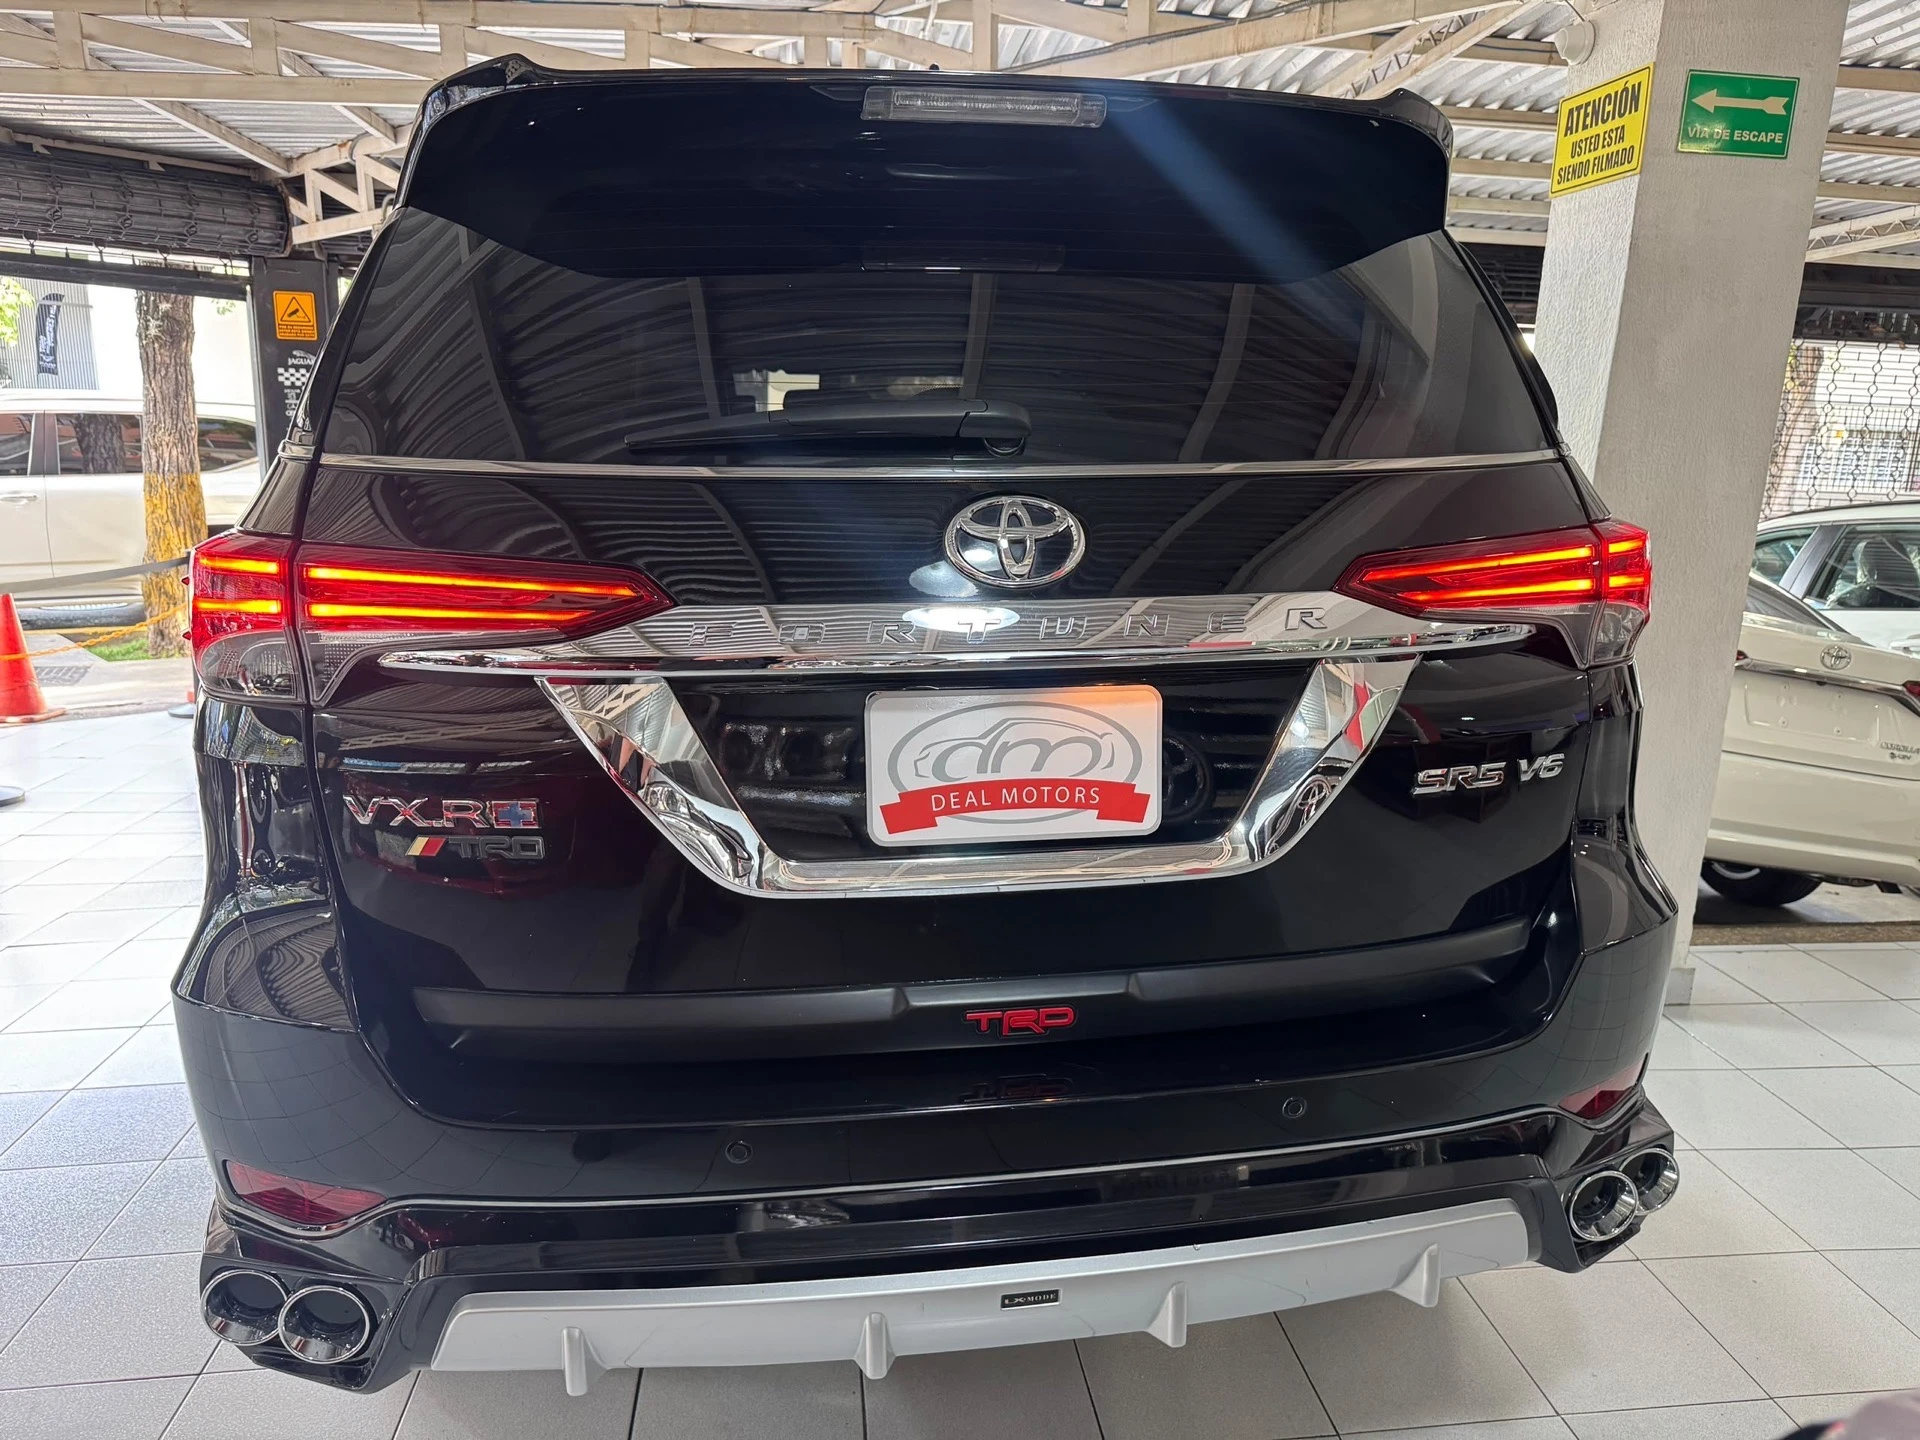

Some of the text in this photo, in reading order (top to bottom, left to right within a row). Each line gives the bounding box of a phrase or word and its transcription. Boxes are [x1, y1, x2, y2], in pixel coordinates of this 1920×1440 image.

[1564, 80, 1642, 137] ATENCIÓN
[1570, 124, 1626, 159] USTED ESTA
[1713, 128, 1731, 140] DE
[1733, 130, 1784, 143] ESCAPE
[1557, 144, 1635, 185] SIENDO FILMADO
[288, 357, 314, 366] JAGUA
[688, 607, 1327, 646] FORTUNER
[1413, 753, 1565, 795] SR5 V6
[931, 786, 1100, 812] DEAL MOTORS
[448, 835, 546, 860] TRD
[966, 1006, 1075, 1036] TRD
